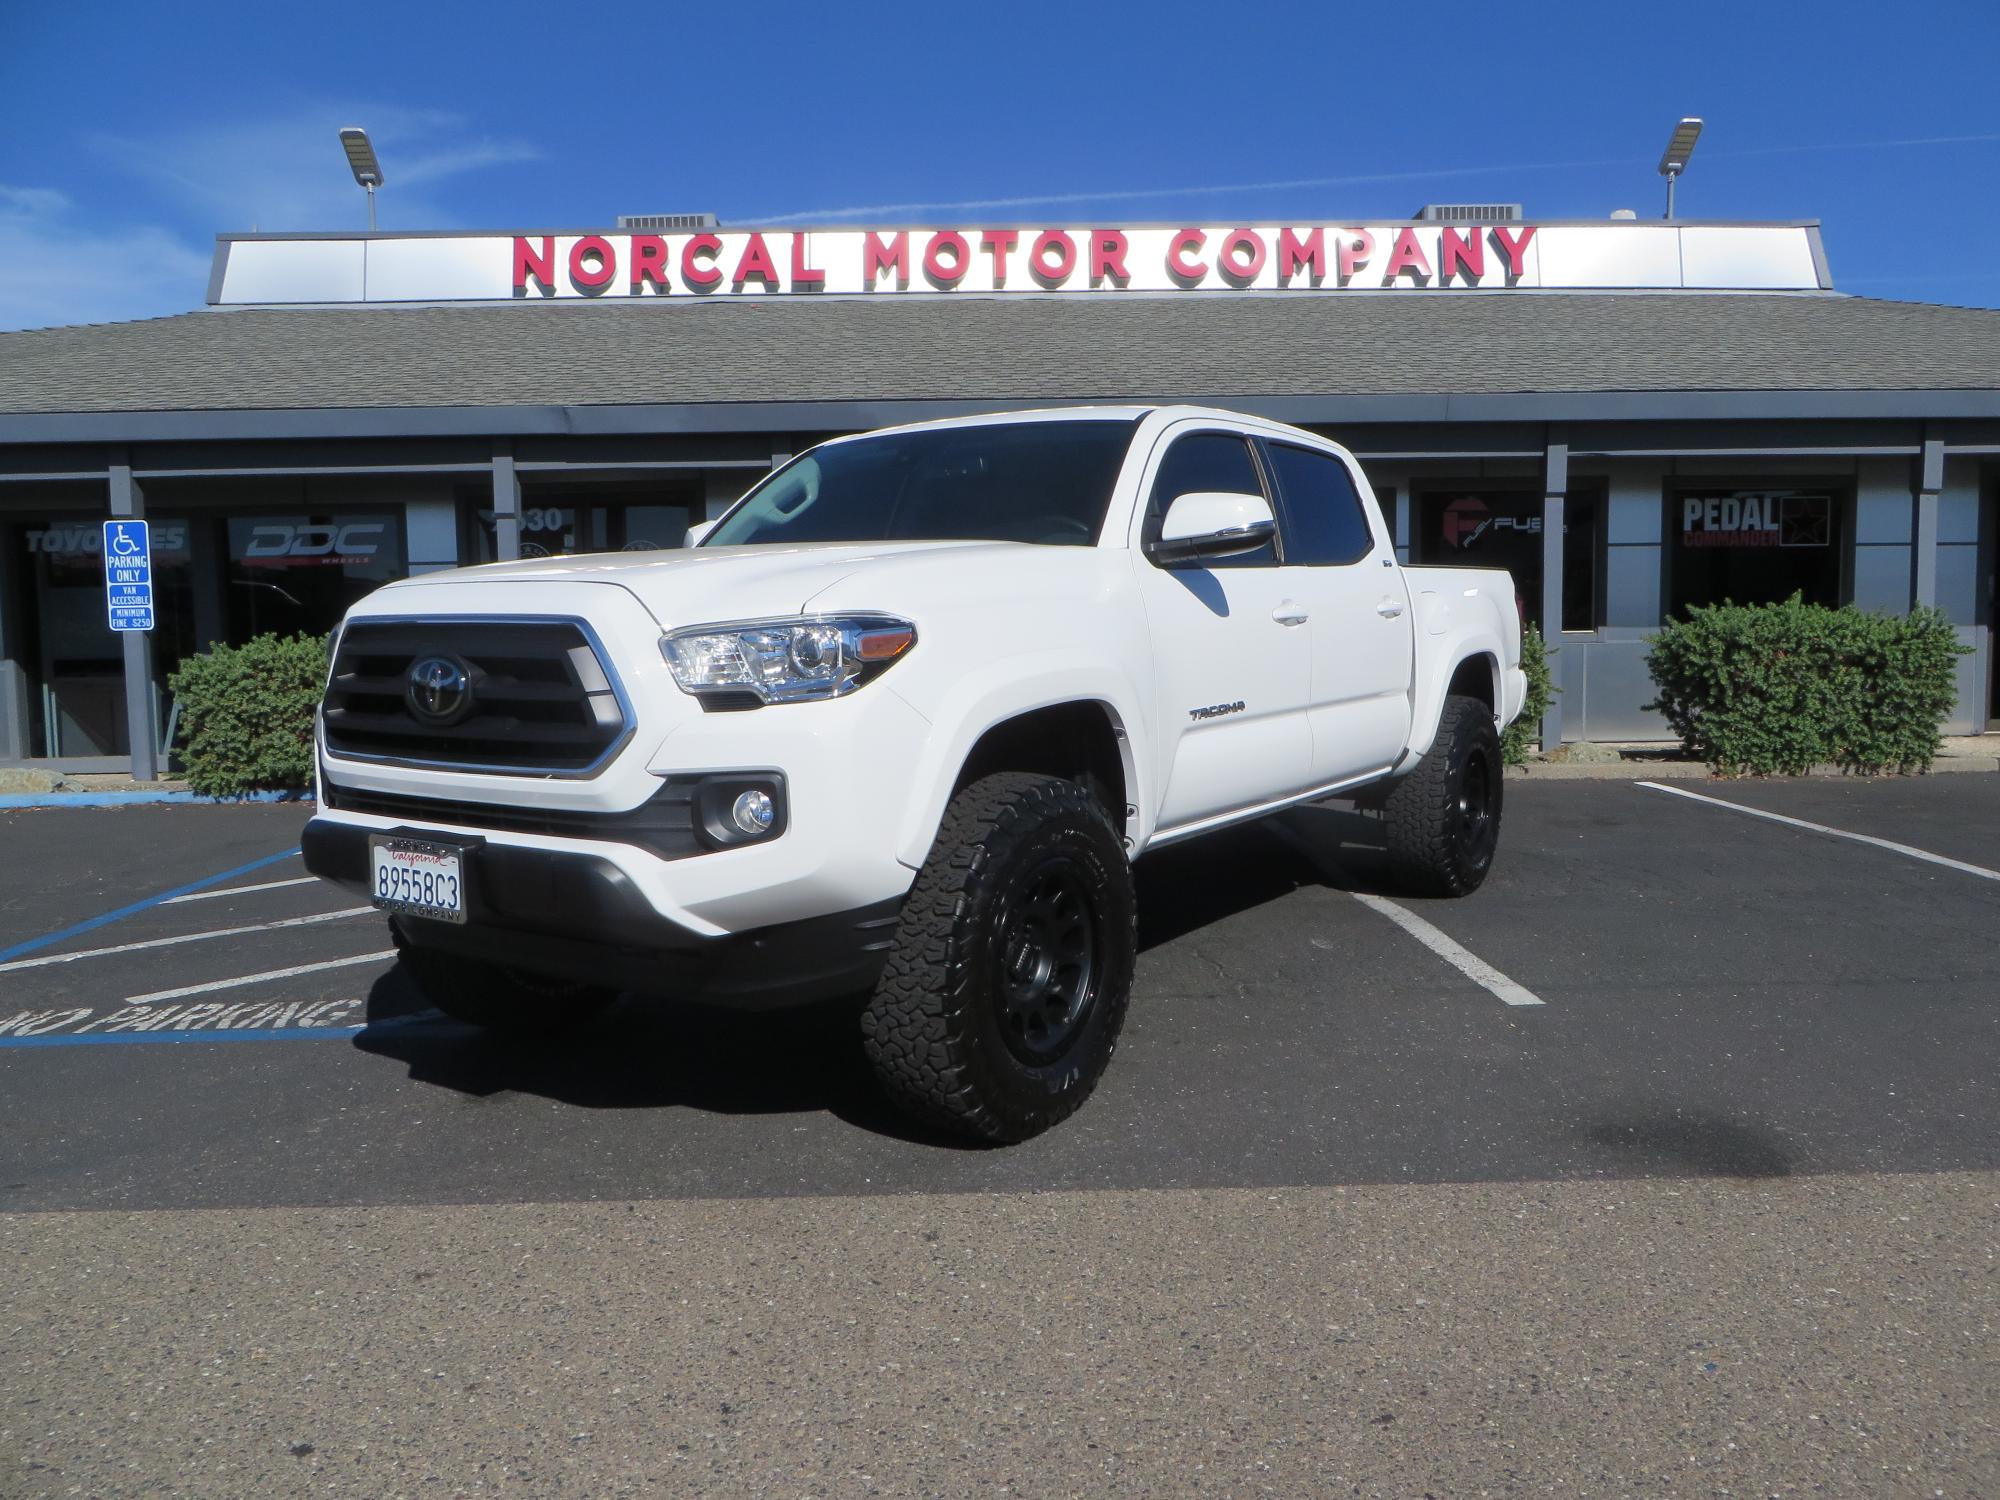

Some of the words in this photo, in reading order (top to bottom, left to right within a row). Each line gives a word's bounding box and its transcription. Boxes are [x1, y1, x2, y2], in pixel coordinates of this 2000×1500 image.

[512, 234, 827, 298] NORCAL
[863, 229, 1131, 293] MOTOR
[1165, 226, 1537, 289] COMPANY
[1683, 498, 1779, 531] PEDAL
[1494, 517, 1542, 531] FUE
[245, 523, 385, 557] DDC
[1683, 531, 1779, 547] COMMANDER
[109, 555, 147, 569] PARKING
[321, 556, 370, 565] WHEELS
[116, 569, 140, 582] ONLY
[122, 586, 137, 595] VAN
[112, 595, 149, 606] ACCESSIBLE
[116, 608, 146, 618] MINIMUM
[112, 618, 128, 628] FINE
[132, 618, 151, 628] $250
[1189, 700, 1246, 721] TACOMA
[379, 864, 458, 909] 89558C3
[72, 999, 363, 1034] PARKING
